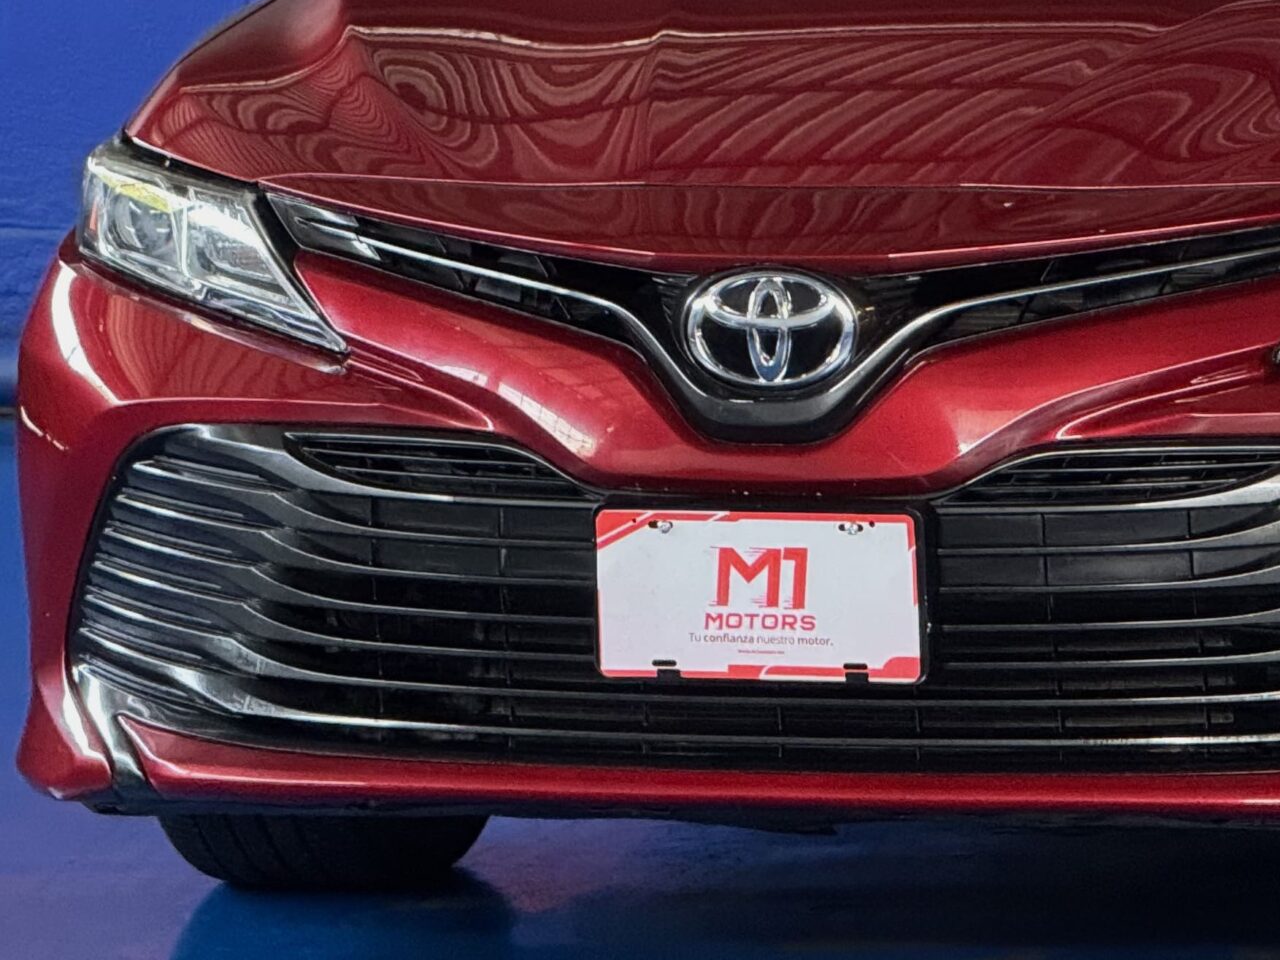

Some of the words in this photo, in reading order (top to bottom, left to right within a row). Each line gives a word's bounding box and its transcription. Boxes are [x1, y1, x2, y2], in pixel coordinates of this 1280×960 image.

[709, 546, 808, 609] M1
[704, 613, 817, 631] MOTORS
[689, 632, 702, 642] Tu
[704, 633, 754, 644] confianza
[757, 635, 795, 645] nuestro
[797, 637, 834, 647] motor.
